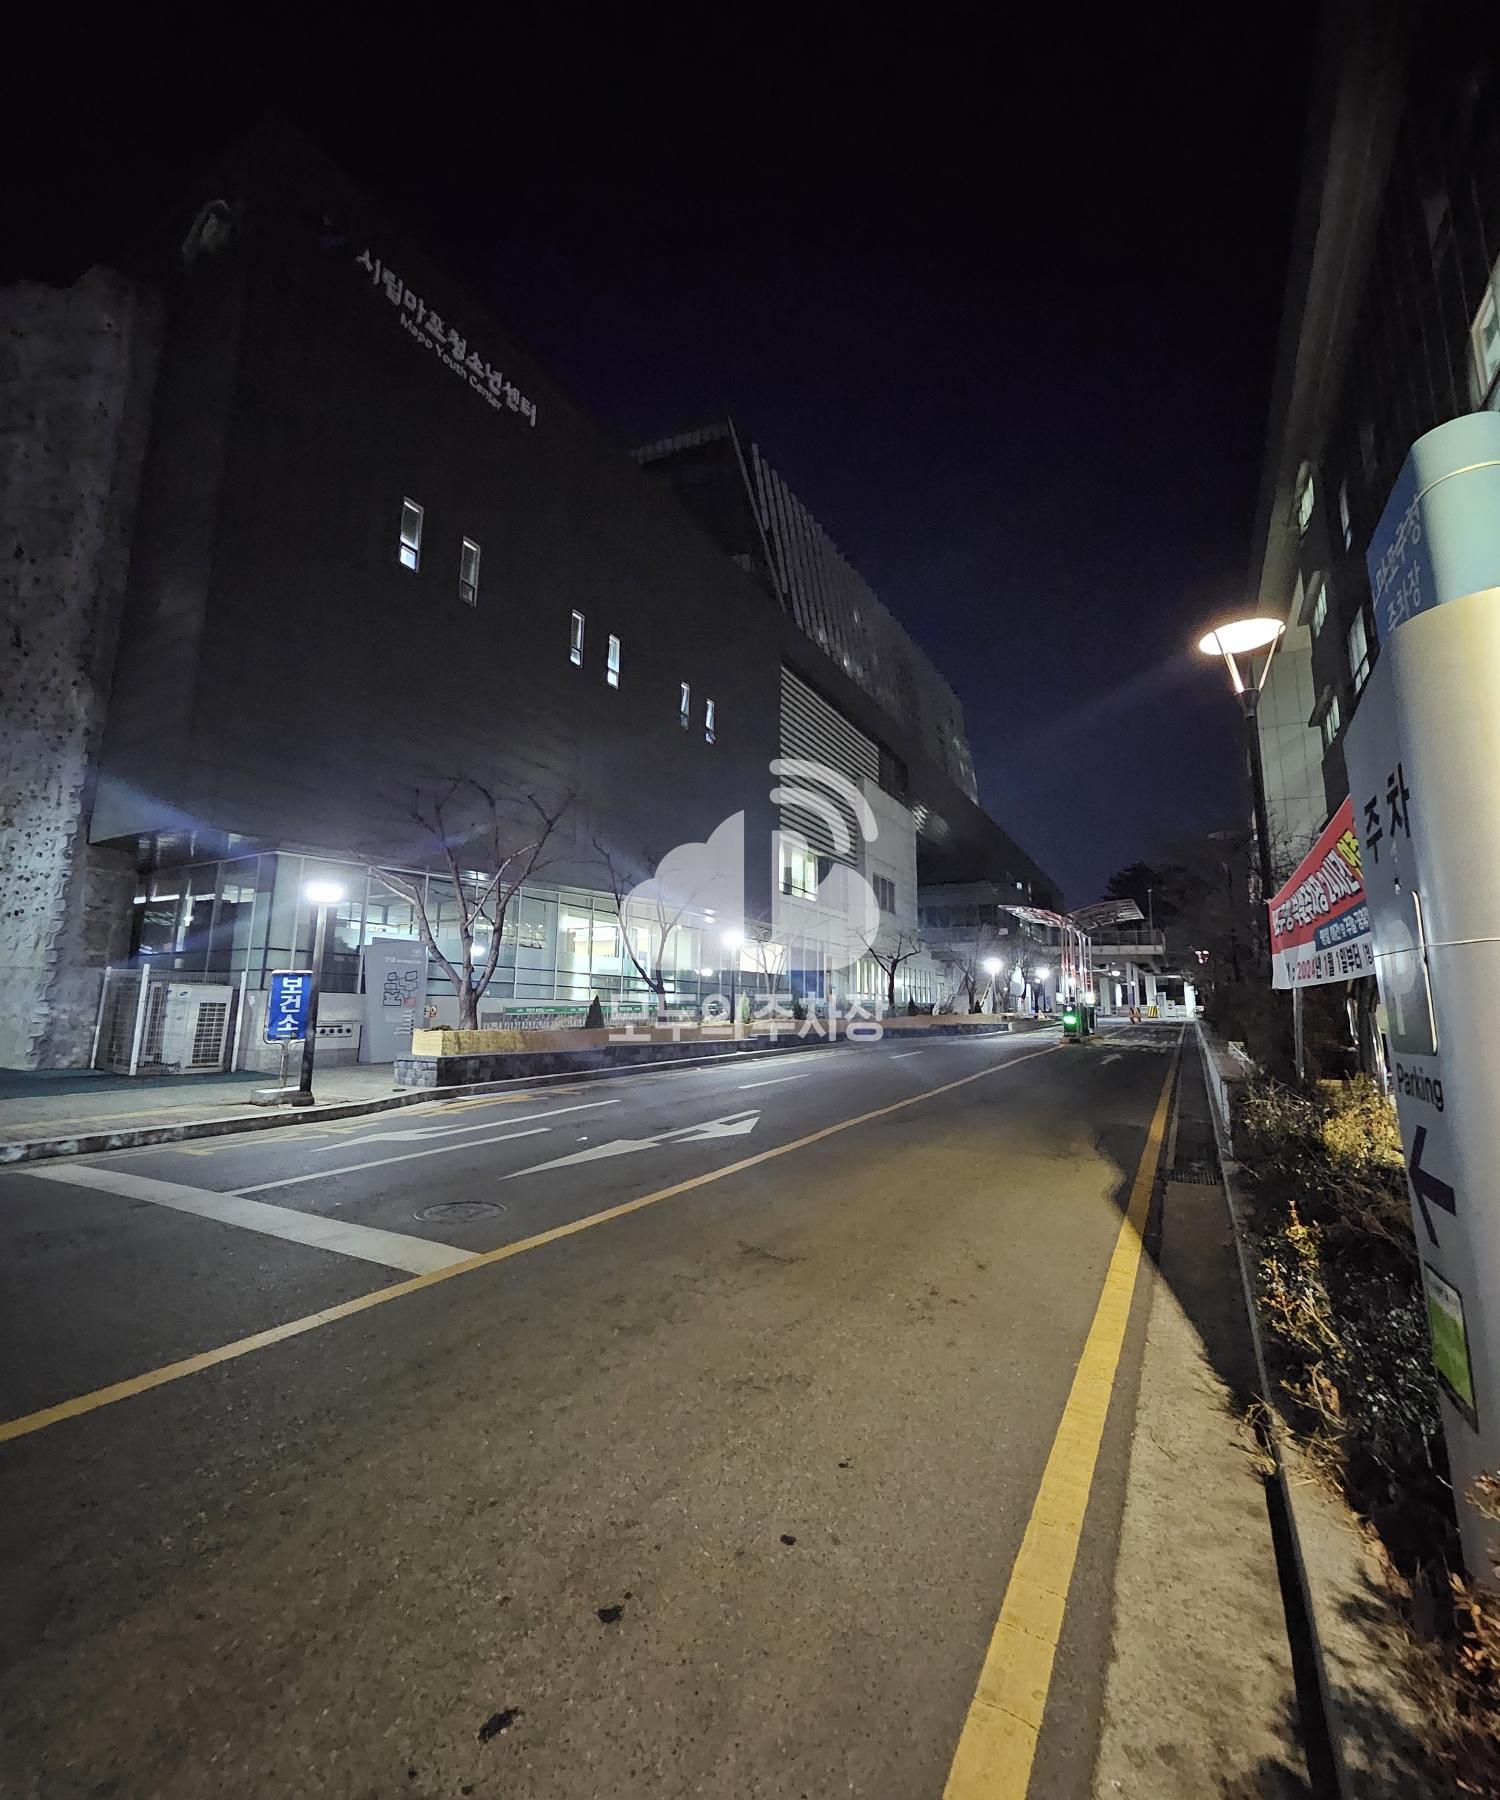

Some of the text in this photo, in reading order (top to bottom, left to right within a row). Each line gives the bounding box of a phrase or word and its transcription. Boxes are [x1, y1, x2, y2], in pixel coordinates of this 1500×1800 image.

[400, 313, 503, 411] Mapo Youth Center
[1364, 761, 1411, 865] 주차
[277, 977, 303, 1031] 보건소
[1396, 1062, 1444, 1113] Parking
